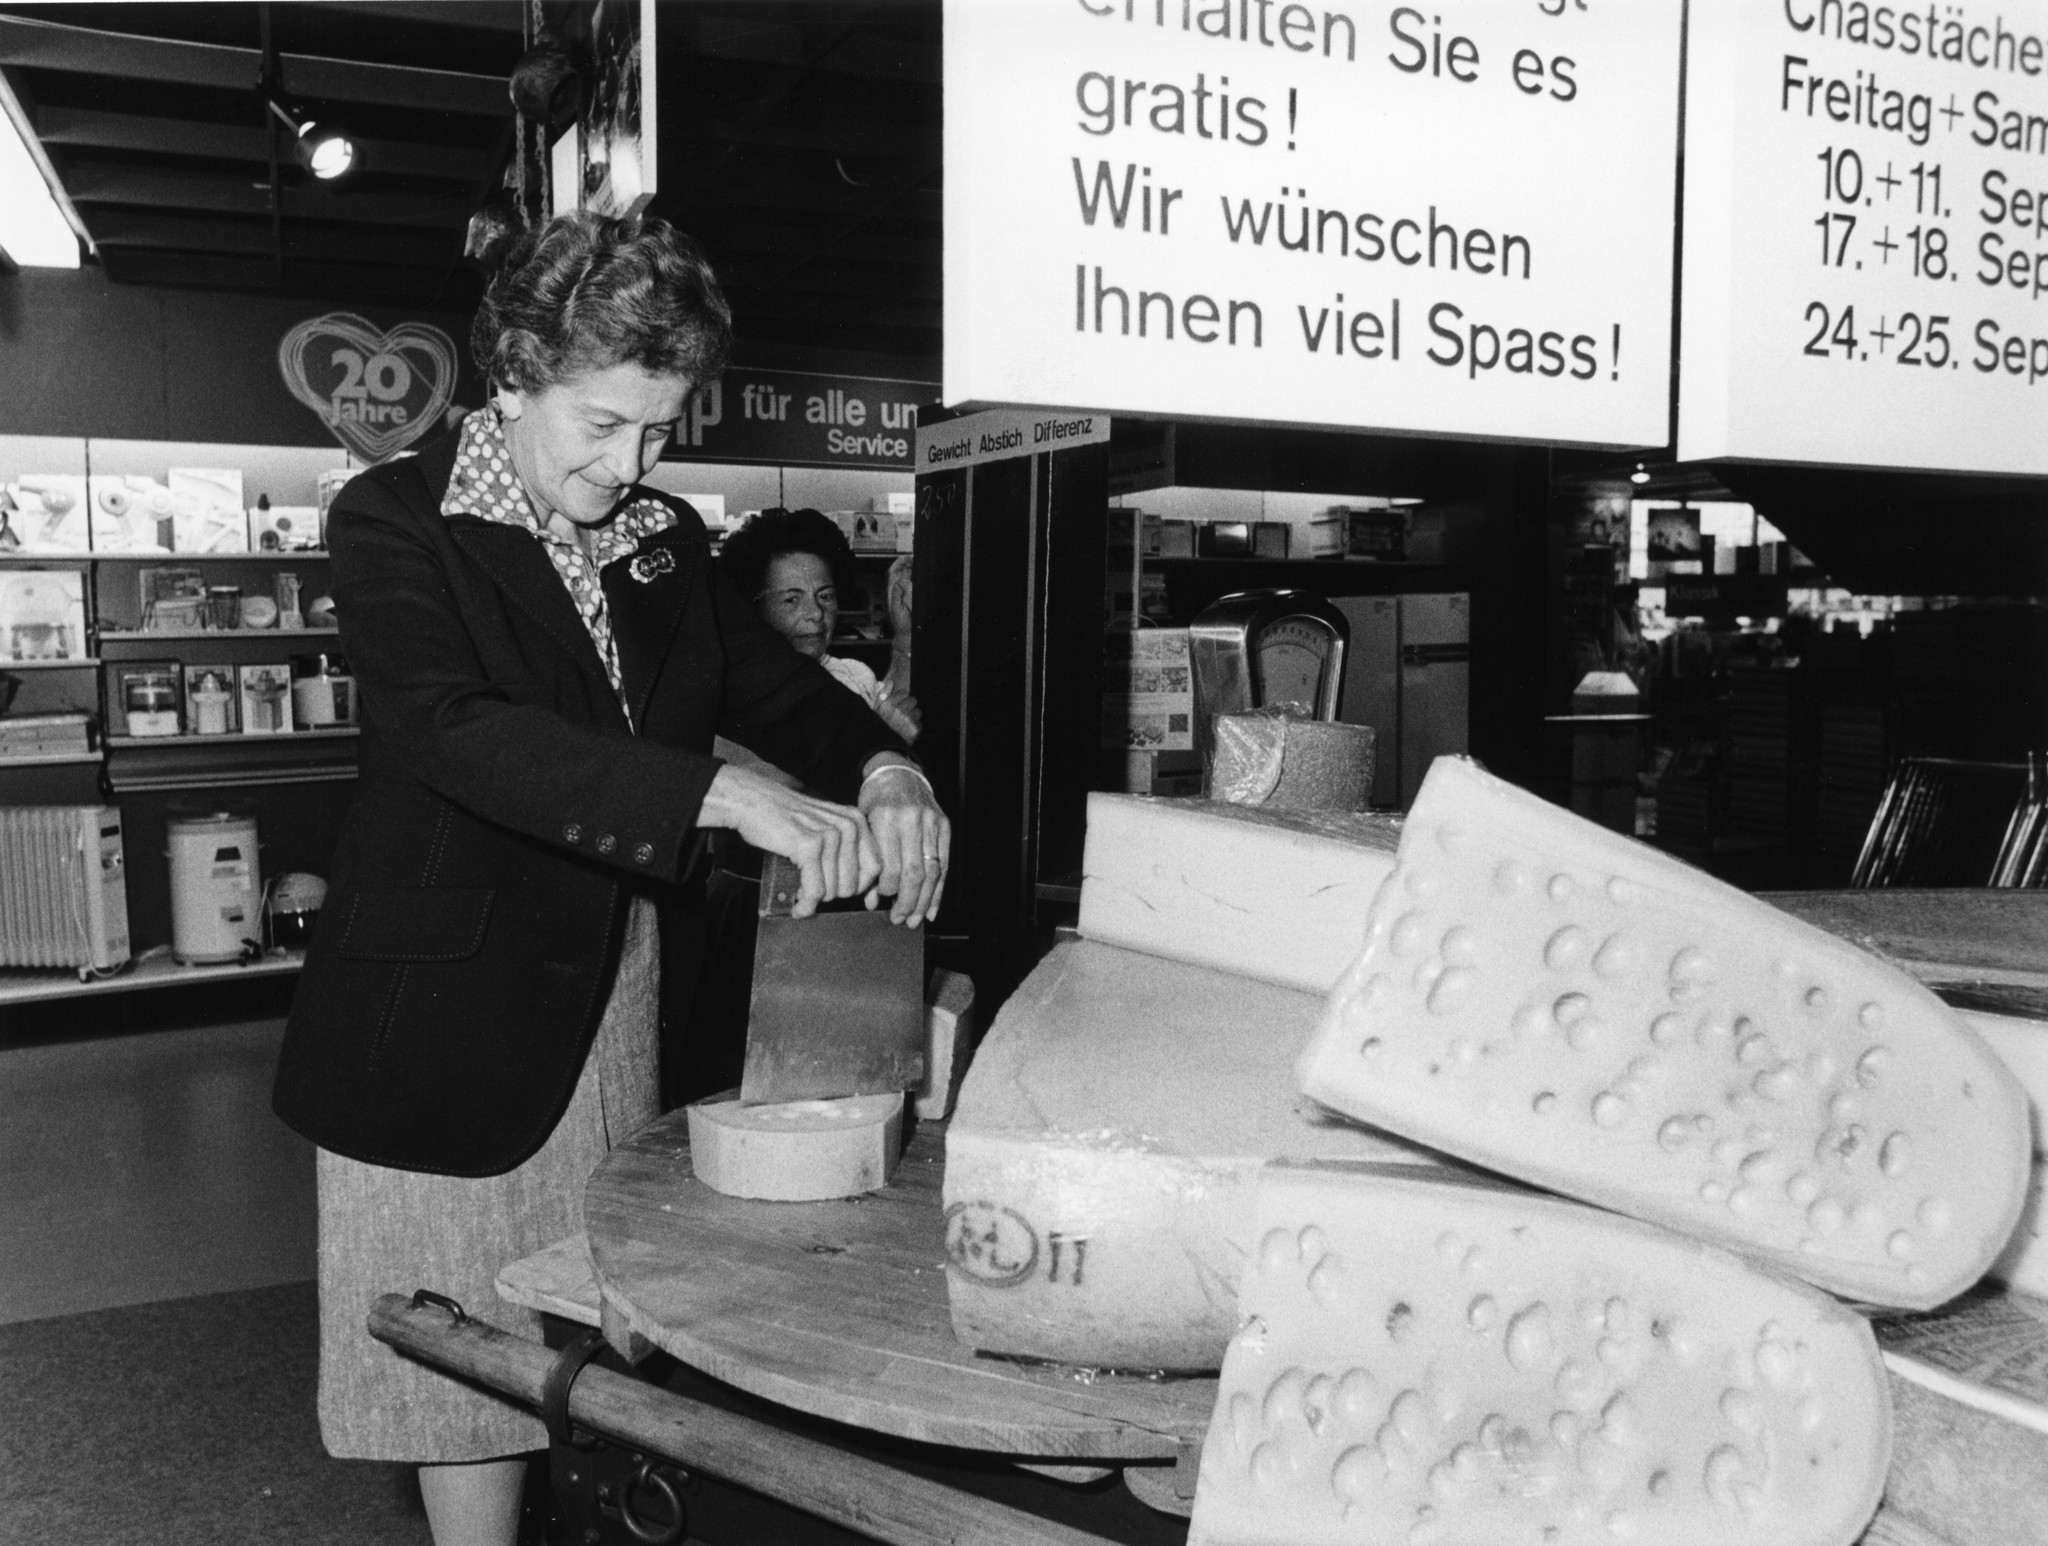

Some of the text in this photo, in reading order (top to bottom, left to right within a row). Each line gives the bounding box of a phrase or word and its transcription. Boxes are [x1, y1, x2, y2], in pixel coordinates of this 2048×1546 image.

[1388, 7, 1480, 83] Sie
[1512, 48, 1578, 102] es
[1076, 70, 1298, 151] gratis!
[1071, 156, 1532, 280] Wir wünschen
[1075, 264, 1622, 382] Ihnen viel Spass!
[331, 348, 411, 401] 20
[330, 396, 407, 427] Jahre
[741, 383, 792, 421] für
[805, 389, 867, 427] alle
[827, 428, 908, 457] Service
[928, 418, 1093, 463] Gewicht Abstich Differenz
